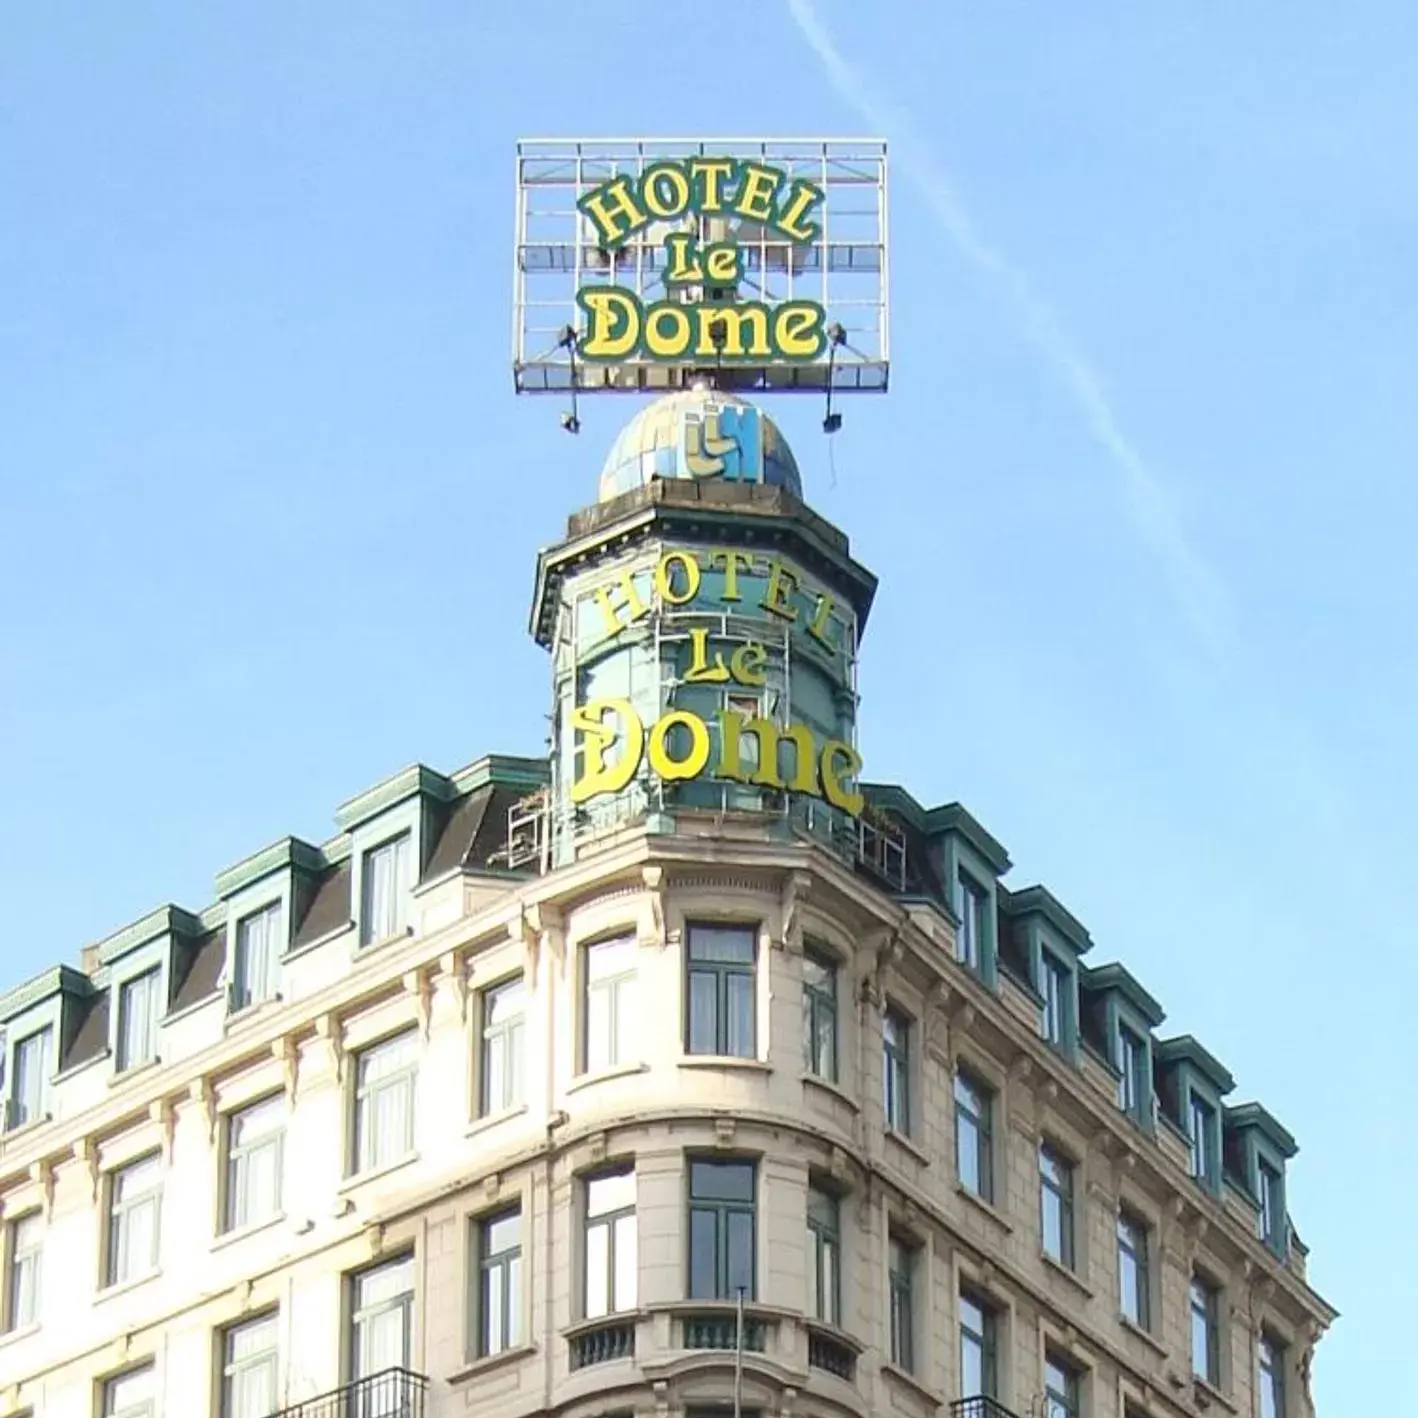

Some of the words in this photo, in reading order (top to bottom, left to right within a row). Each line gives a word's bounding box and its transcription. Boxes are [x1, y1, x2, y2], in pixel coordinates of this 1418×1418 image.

[580, 159, 823, 245] HOTEL
[666, 236, 741, 282] Le
[580, 288, 824, 357] Dome
[595, 549, 838, 657] HOTEL
[683, 628, 767, 685] Le
[571, 699, 865, 817] Dome
